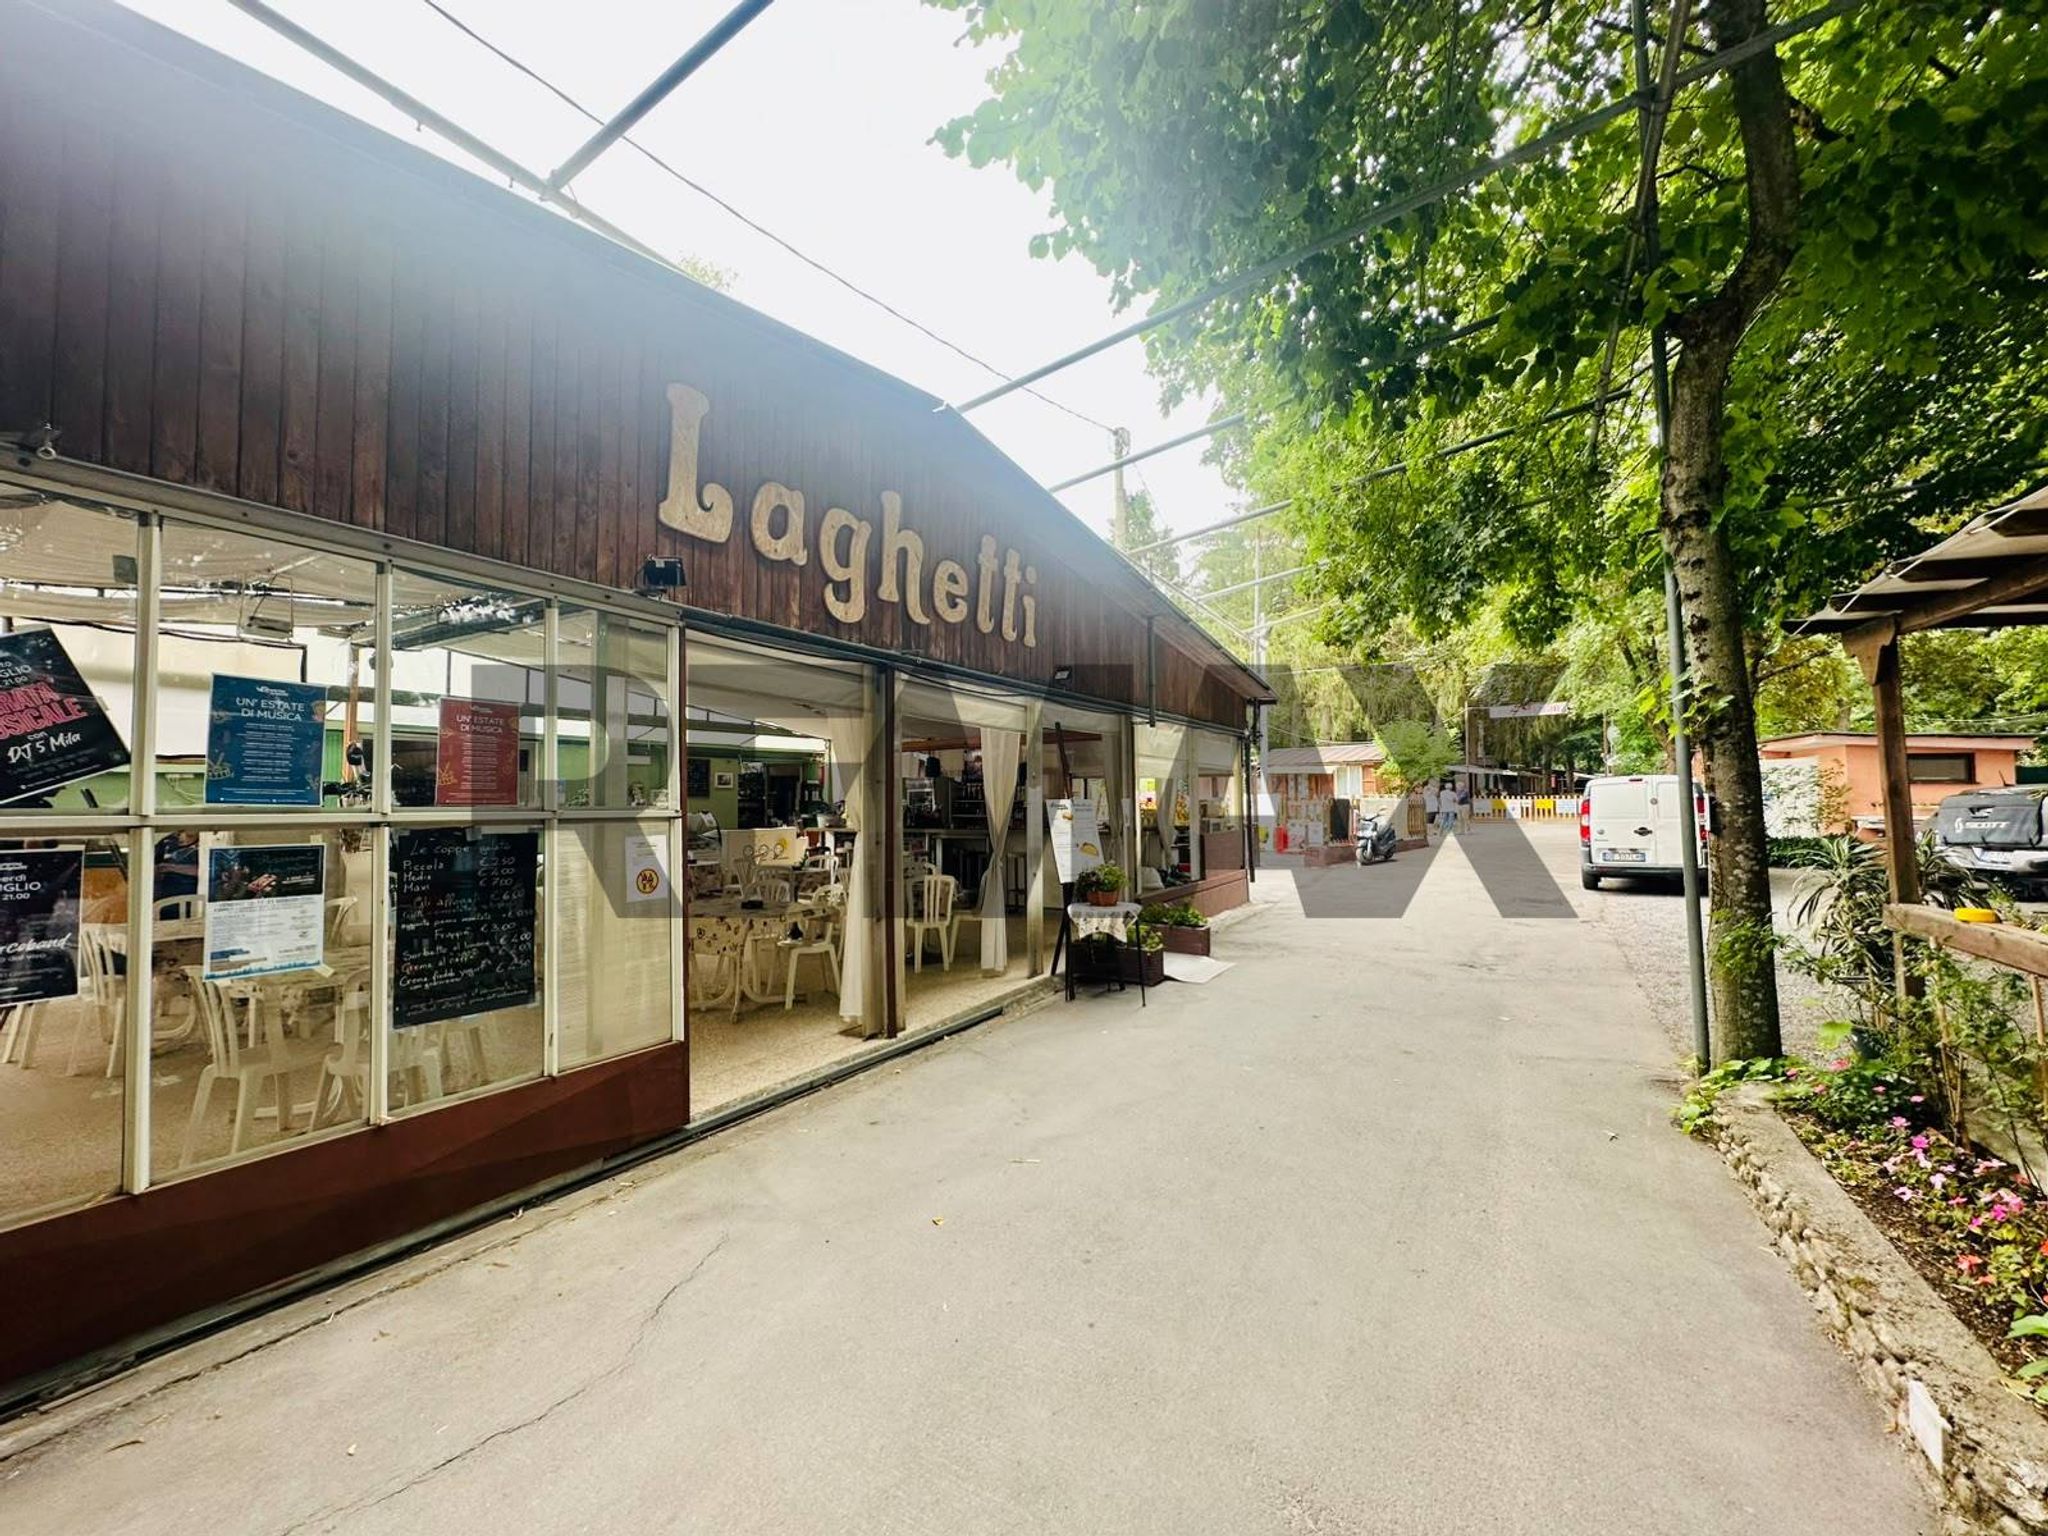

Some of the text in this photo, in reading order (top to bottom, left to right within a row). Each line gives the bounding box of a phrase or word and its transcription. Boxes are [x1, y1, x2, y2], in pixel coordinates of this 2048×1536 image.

[658, 382, 1038, 648] Laghetti
[261, 700, 305, 712] ESTATE
[240, 708, 302, 721] DI MUSICA
[473, 716, 504, 725] ESTATE
[460, 723, 503, 733] DI MUSICA
[8, 732, 82, 764] DJ 5 Mila
[1965, 821, 2010, 829] SCOTT
